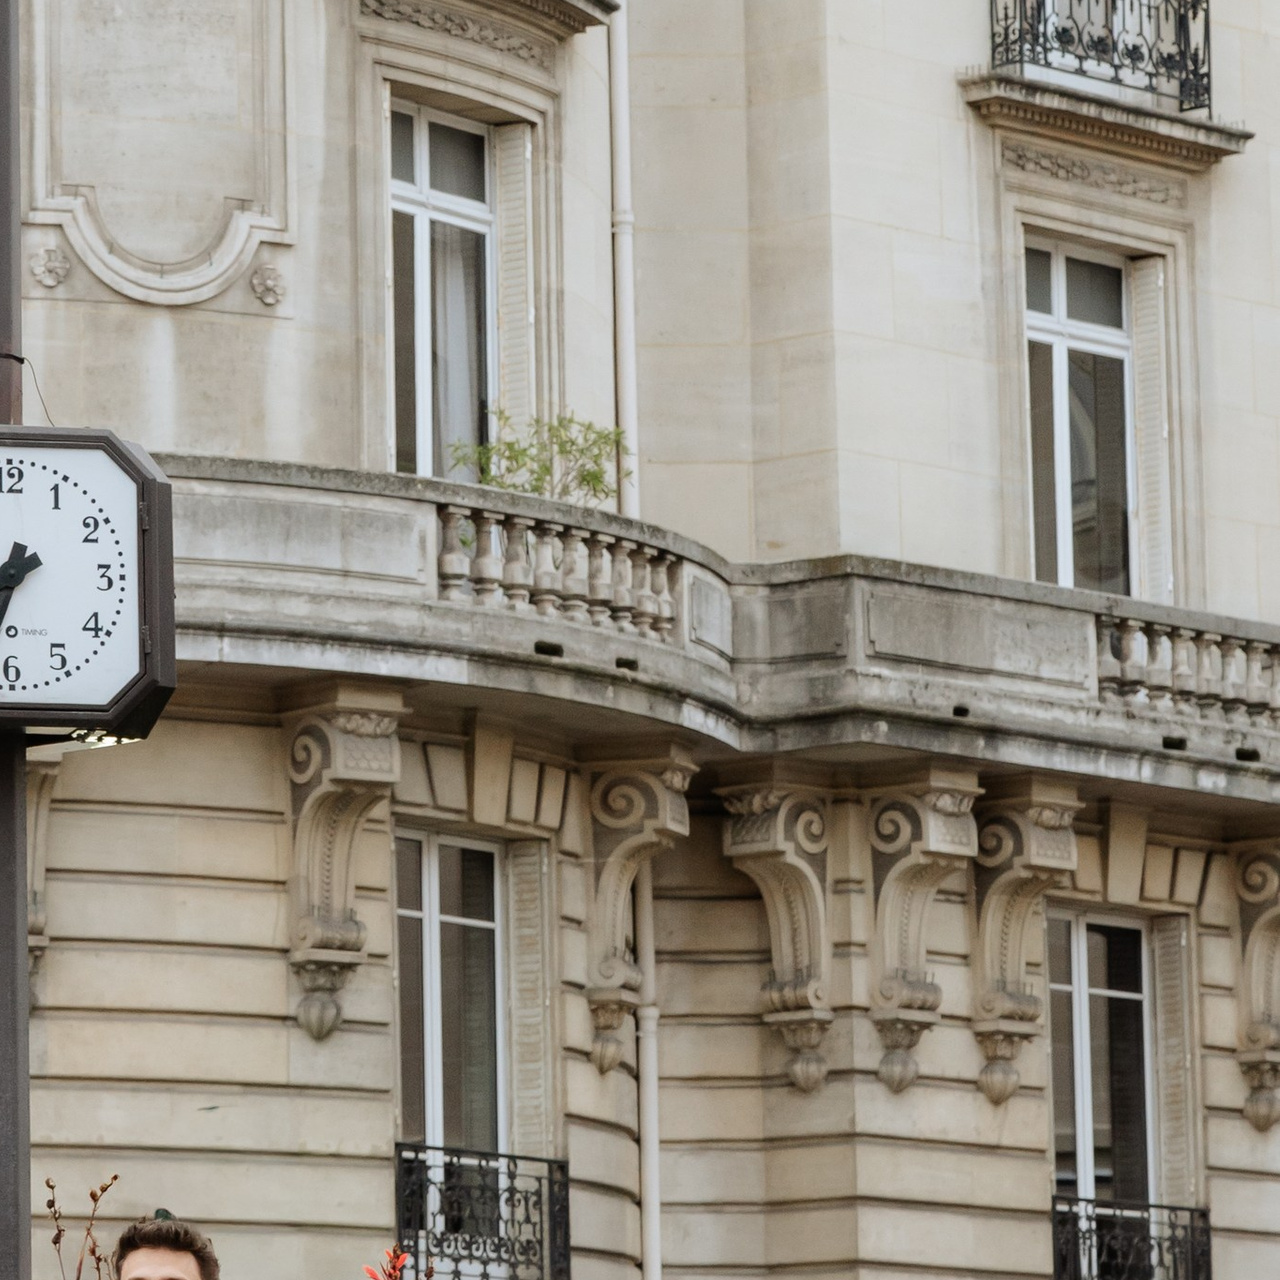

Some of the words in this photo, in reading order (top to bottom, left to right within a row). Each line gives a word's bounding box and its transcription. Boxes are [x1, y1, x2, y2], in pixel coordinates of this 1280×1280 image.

[49, 483, 61, 510] 1
[82, 516, 100, 544] 2
[96, 563, 114, 591] 3
[21, 628, 48, 637] TIMING
[81, 611, 104, 639] 4
[2, 655, 21, 683] 6
[49, 642, 68, 671] 5
